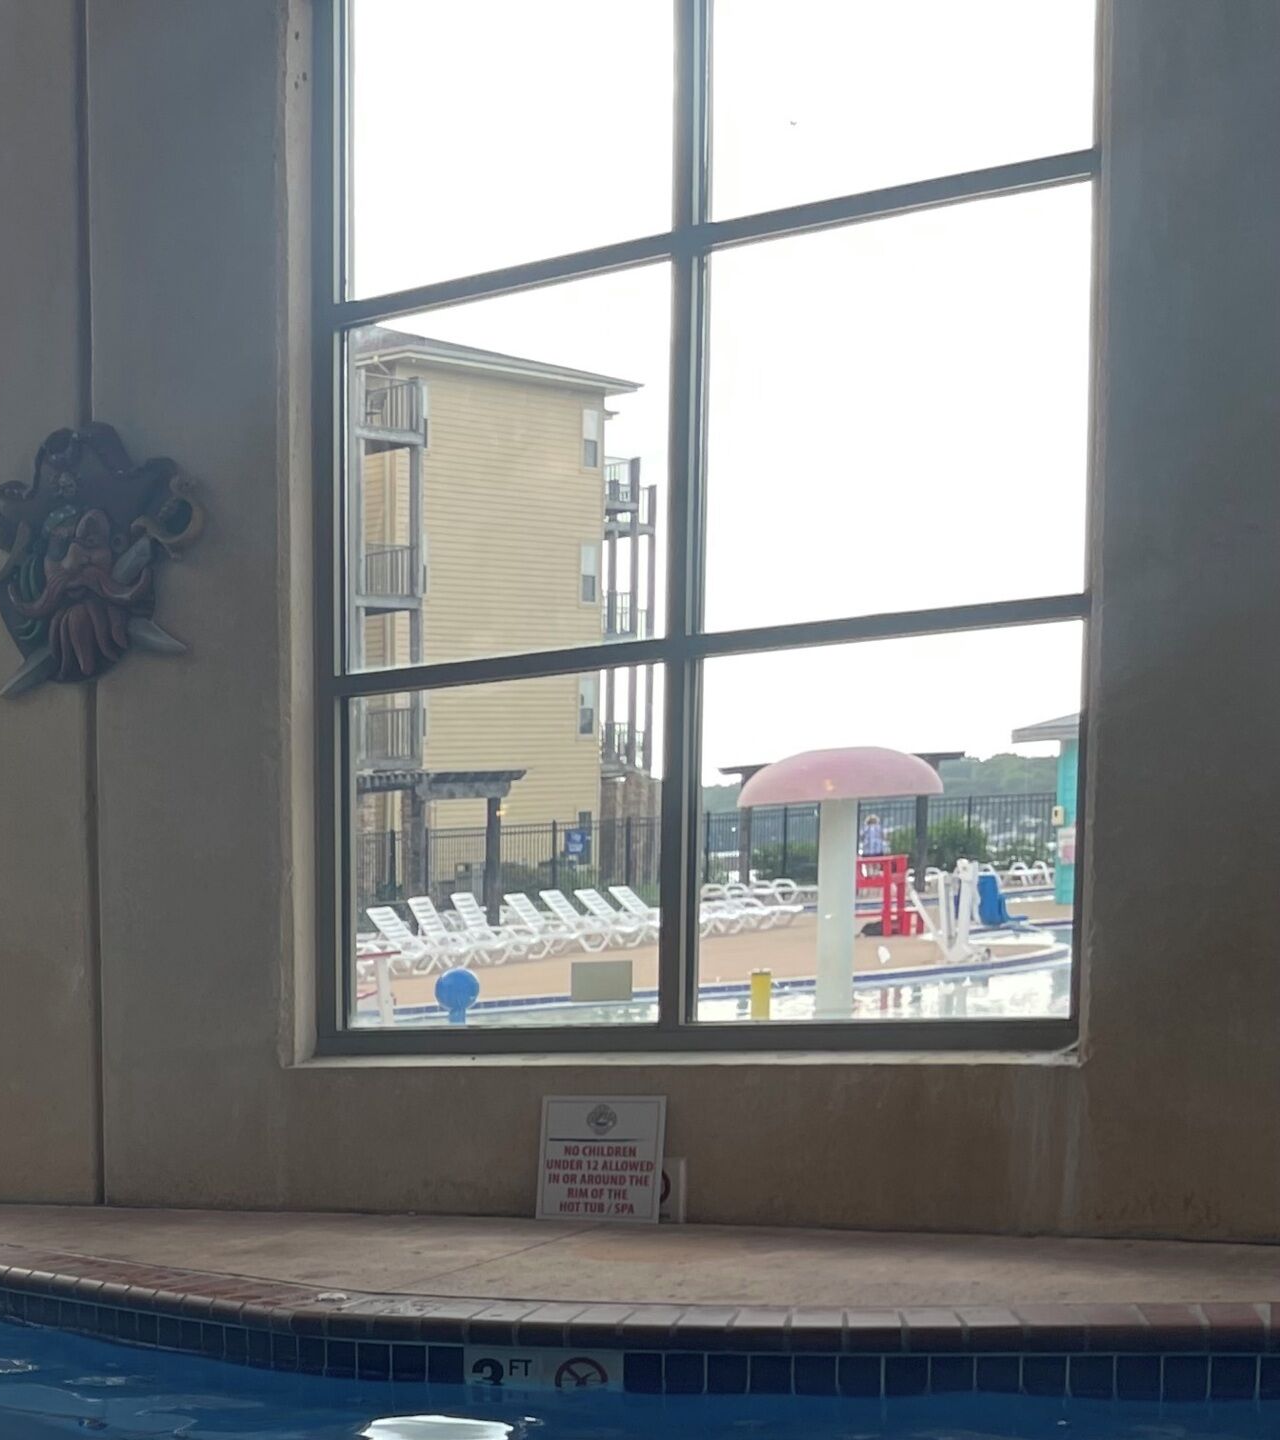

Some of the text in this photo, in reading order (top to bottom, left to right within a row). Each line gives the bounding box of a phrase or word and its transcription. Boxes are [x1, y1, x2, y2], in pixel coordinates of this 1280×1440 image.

[564, 1146, 636, 1157] NO CHILDREN
[546, 1160, 654, 1171] UNDER 12 ALLOWED
[549, 1174, 649, 1186] IN OR AROUND THE
[568, 1188, 628, 1200] RIM OF THE
[560, 1202, 580, 1212] HOT
[584, 1203, 604, 1213] TUB
[615, 1203, 634, 1213] SPA
[509, 1359, 532, 1376] FT
